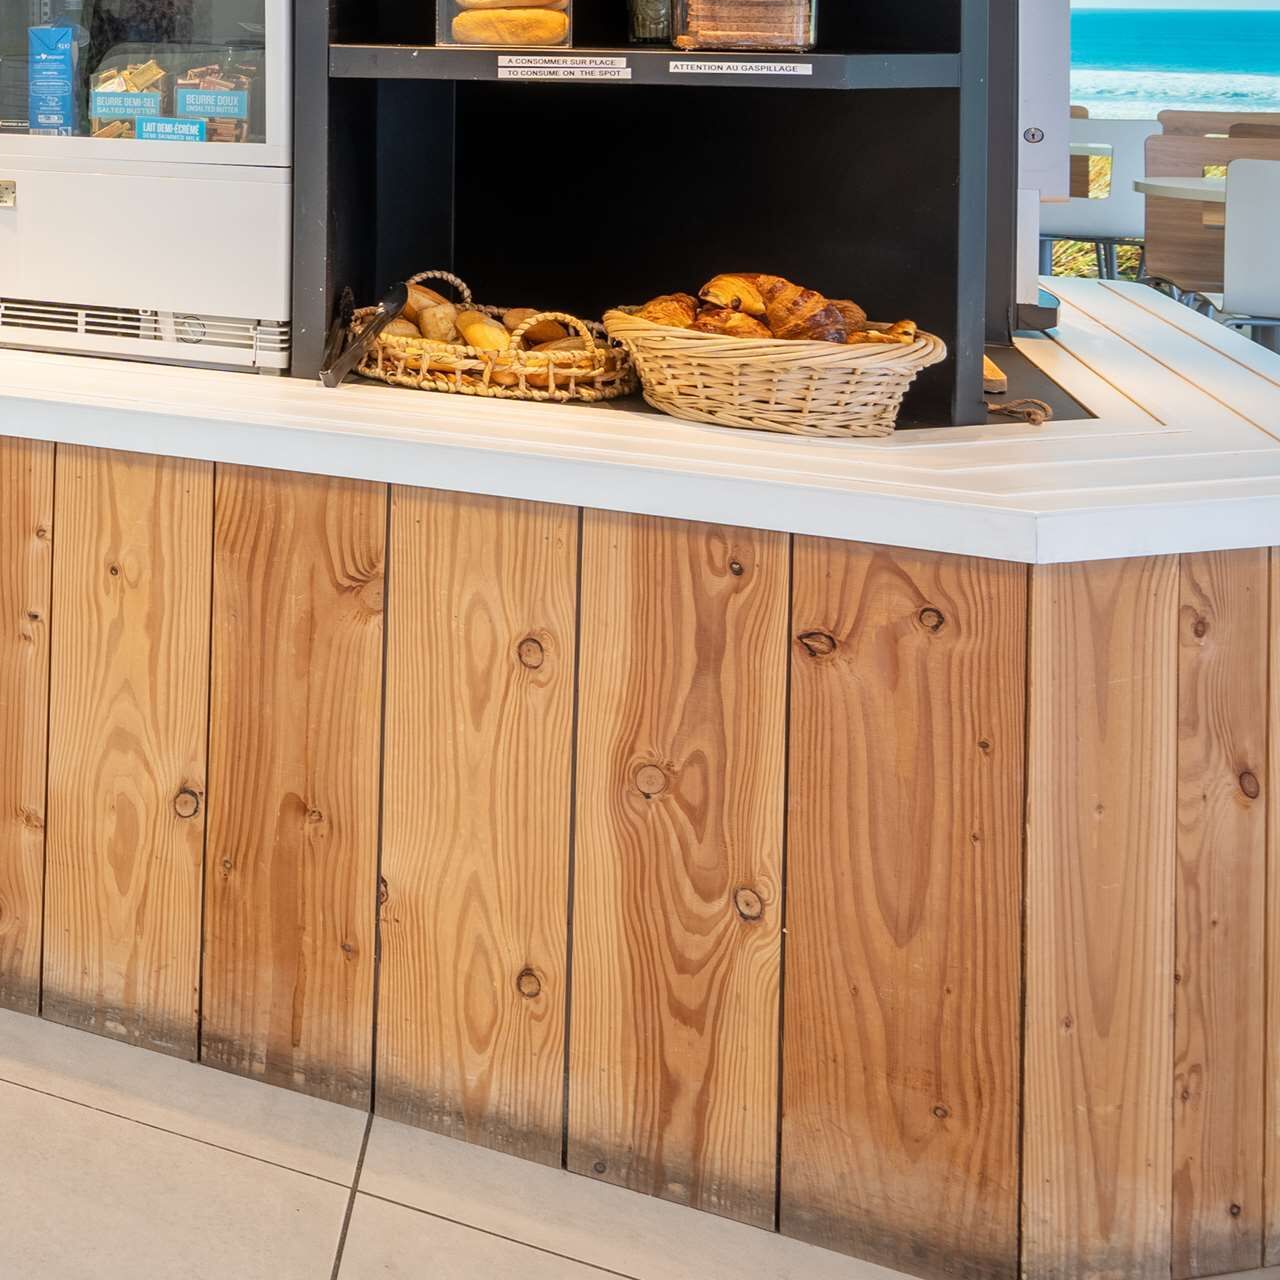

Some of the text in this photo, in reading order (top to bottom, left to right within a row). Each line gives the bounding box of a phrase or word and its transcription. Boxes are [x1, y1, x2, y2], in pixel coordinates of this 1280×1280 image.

[516, 58, 568, 66] CONSOMMER
[673, 64, 724, 72] ATTENTION
[741, 65, 798, 73] GASPILLAGE
[96, 96, 123, 106] BEURRE
[186, 94, 239, 106] BEURRE DOUX
[143, 122, 200, 135] LAIT DEMI-ÉCRÉMÉ
